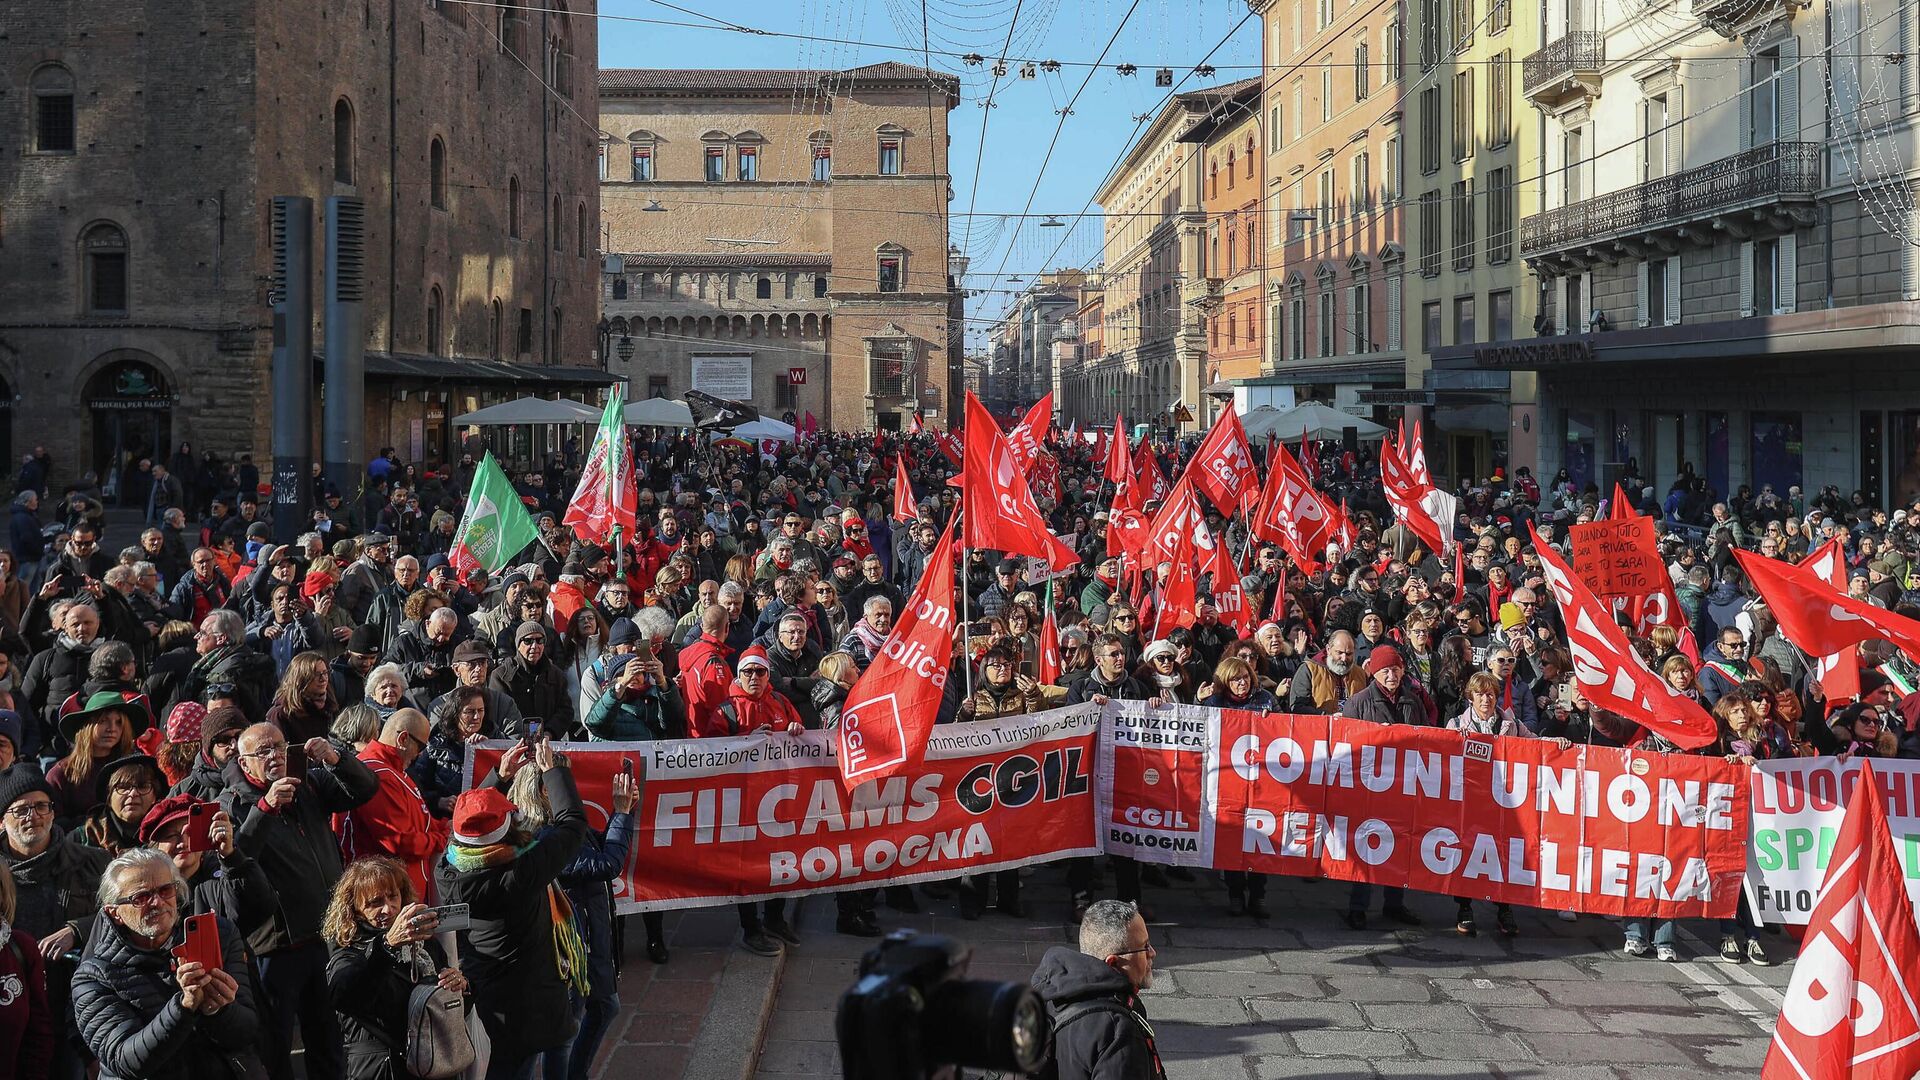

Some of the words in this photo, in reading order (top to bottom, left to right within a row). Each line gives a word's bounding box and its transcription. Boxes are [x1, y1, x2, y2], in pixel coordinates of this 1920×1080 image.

[991, 66, 1007, 77] 15
[1019, 68, 1036, 79] 14
[1156, 74, 1173, 86] 13
[790, 370, 805, 382] W
[1212, 458, 1240, 492] CGIL
[1613, 522, 1641, 538] TUTTO
[1600, 541, 1638, 554] PRIVATO
[1598, 559, 1610, 570] TU
[1614, 556, 1647, 568] SARAI
[1616, 572, 1647, 588] TUTTO
[884, 630, 948, 691] blica
[926, 730, 992, 752] mmercio
[992, 724, 1051, 744] Turismo
[1060, 709, 1102, 730] Serviz
[1114, 716, 1205, 733] FUNZIONE
[844, 712, 868, 773] CGIL
[1114, 731, 1203, 747] PUBBLICA
[1466, 743, 1488, 757] AGD
[655, 747, 760, 770] Federazione
[763, 740, 822, 761] Italiana
[1230, 734, 1465, 801] COMUNI
[1491, 760, 1736, 831] UNIONE
[653, 773, 944, 847] FILCAMS
[955, 746, 1089, 816] CGIL
[1124, 806, 1189, 829] CGIL
[1110, 829, 1198, 851] BOLOGNA
[769, 822, 994, 887] BOLOGNA
[1242, 807, 1395, 866] RENO
[1420, 826, 1712, 902] GALLIERA
[1757, 885, 1820, 912] Fuo
